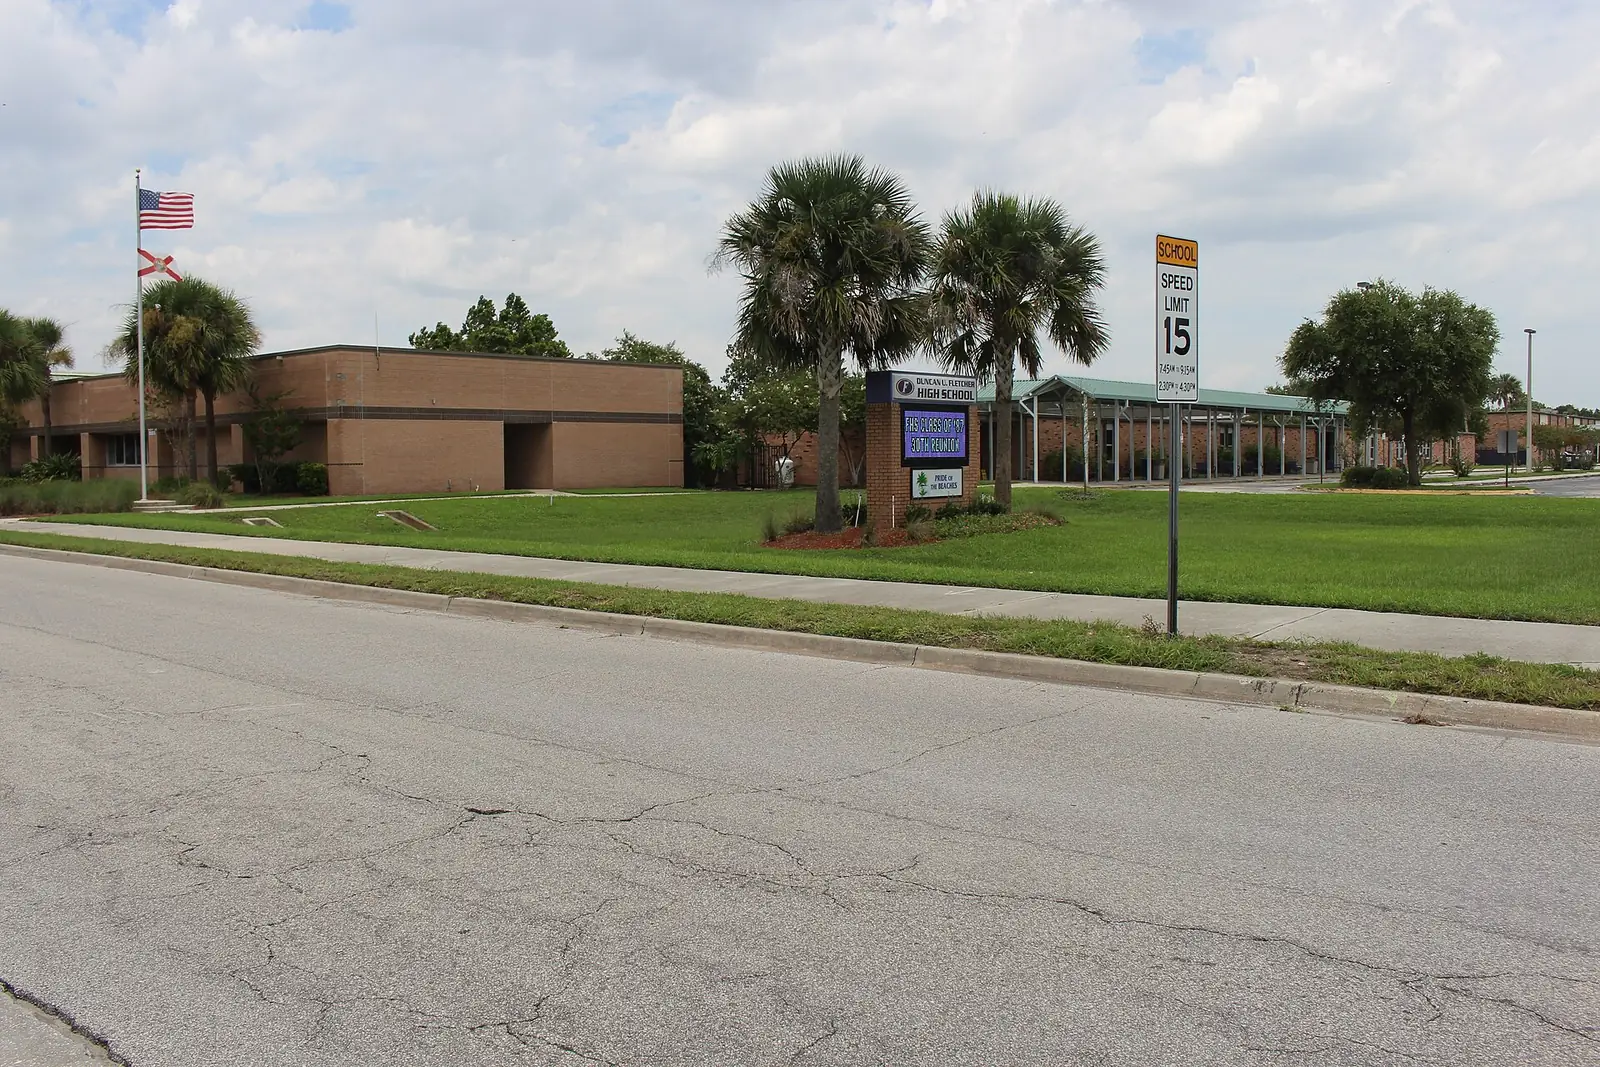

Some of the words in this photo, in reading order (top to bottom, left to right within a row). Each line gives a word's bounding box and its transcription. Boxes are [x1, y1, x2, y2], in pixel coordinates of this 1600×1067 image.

[1159, 241, 1196, 262] SCHOOL
[1161, 272, 1193, 291] SPEED
[1165, 296, 1189, 313] LIMIT
[1164, 316, 1190, 356] 15
[916, 378, 940, 386] DUNCAN
[949, 380, 975, 388] FLETCHER
[917, 388, 940, 399] HIGH
[941, 389, 975, 401] SCHOOL
[905, 417, 919, 432] FHS
[920, 417, 942, 432] CLASS
[943, 418, 952, 433] OF
[911, 437, 929, 452] 30TH
[931, 437, 960, 452] REUNION
[934, 474, 947, 482] PRIDE
[938, 482, 958, 490] BEACHES
